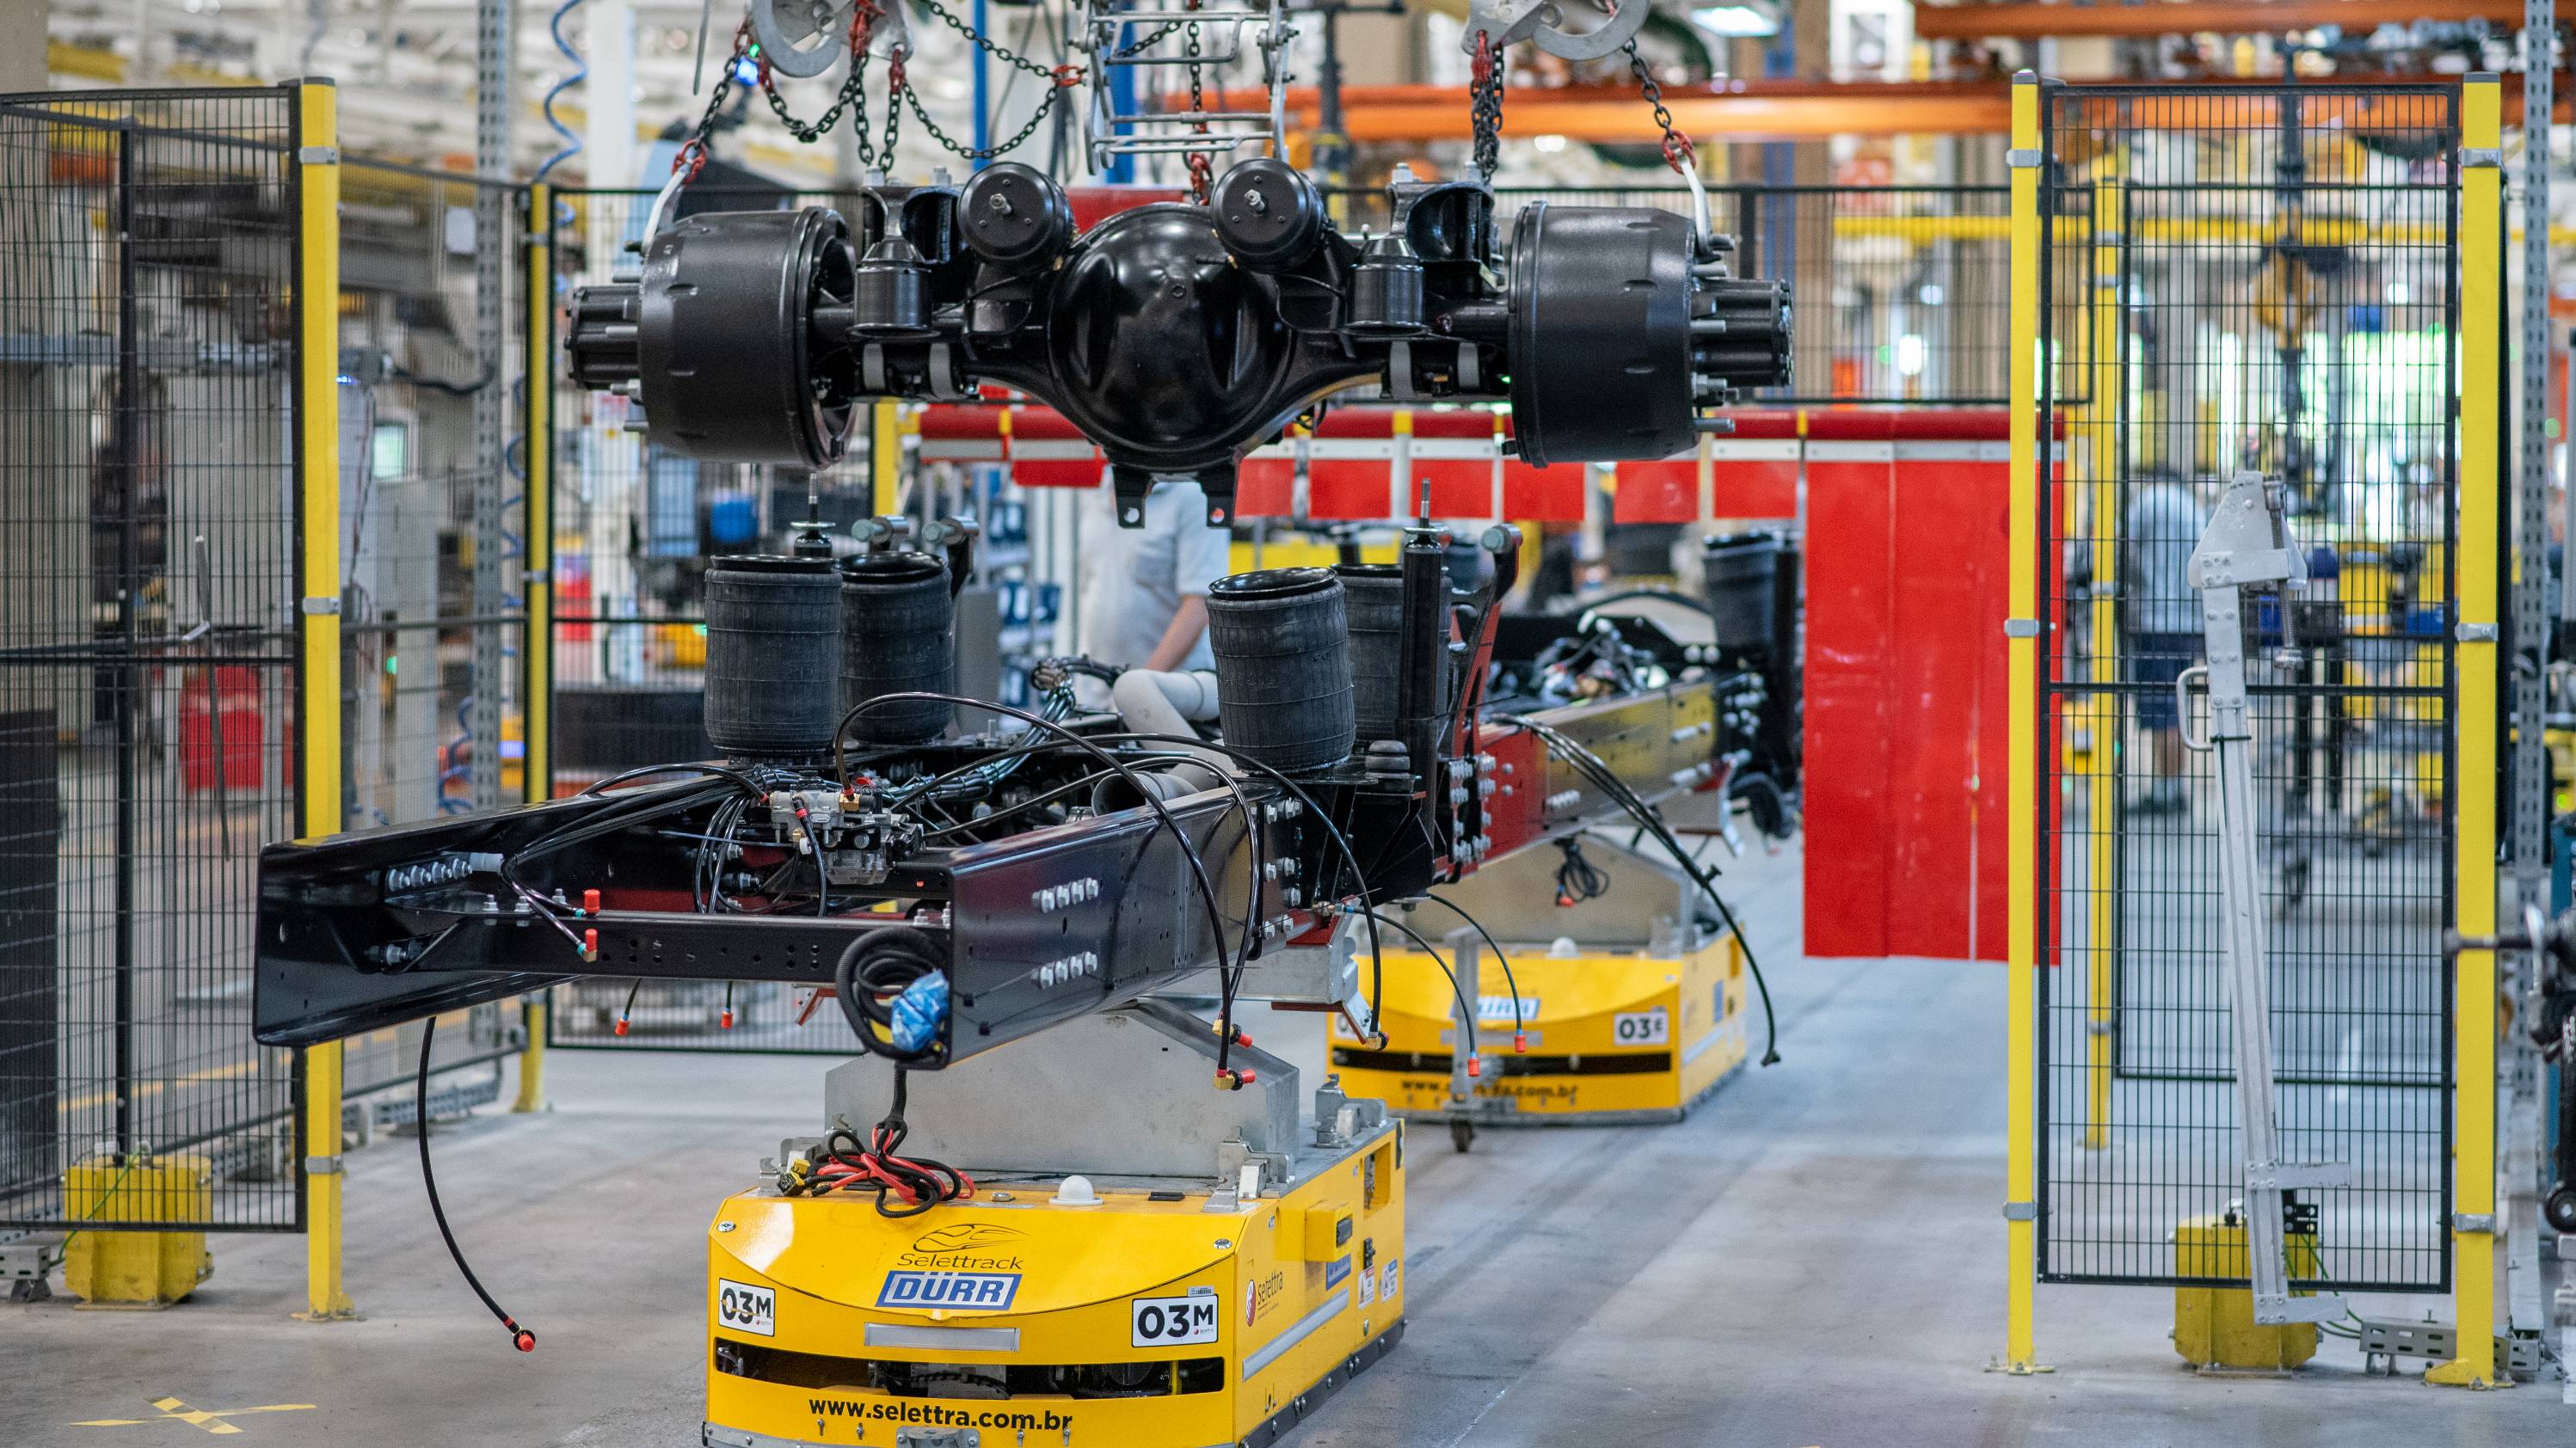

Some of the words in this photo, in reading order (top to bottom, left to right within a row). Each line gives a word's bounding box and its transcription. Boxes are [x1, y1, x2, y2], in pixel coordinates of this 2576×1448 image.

[897, 1253, 1024, 1270] Selettrack
[892, 1272, 1005, 1303] DÜRR
[1257, 1269, 1283, 1305] selettra
[722, 1287, 772, 1325] 03M
[1137, 1304, 1214, 1339] 03M
[808, 1399, 1073, 1431] www.selettra.com.br
